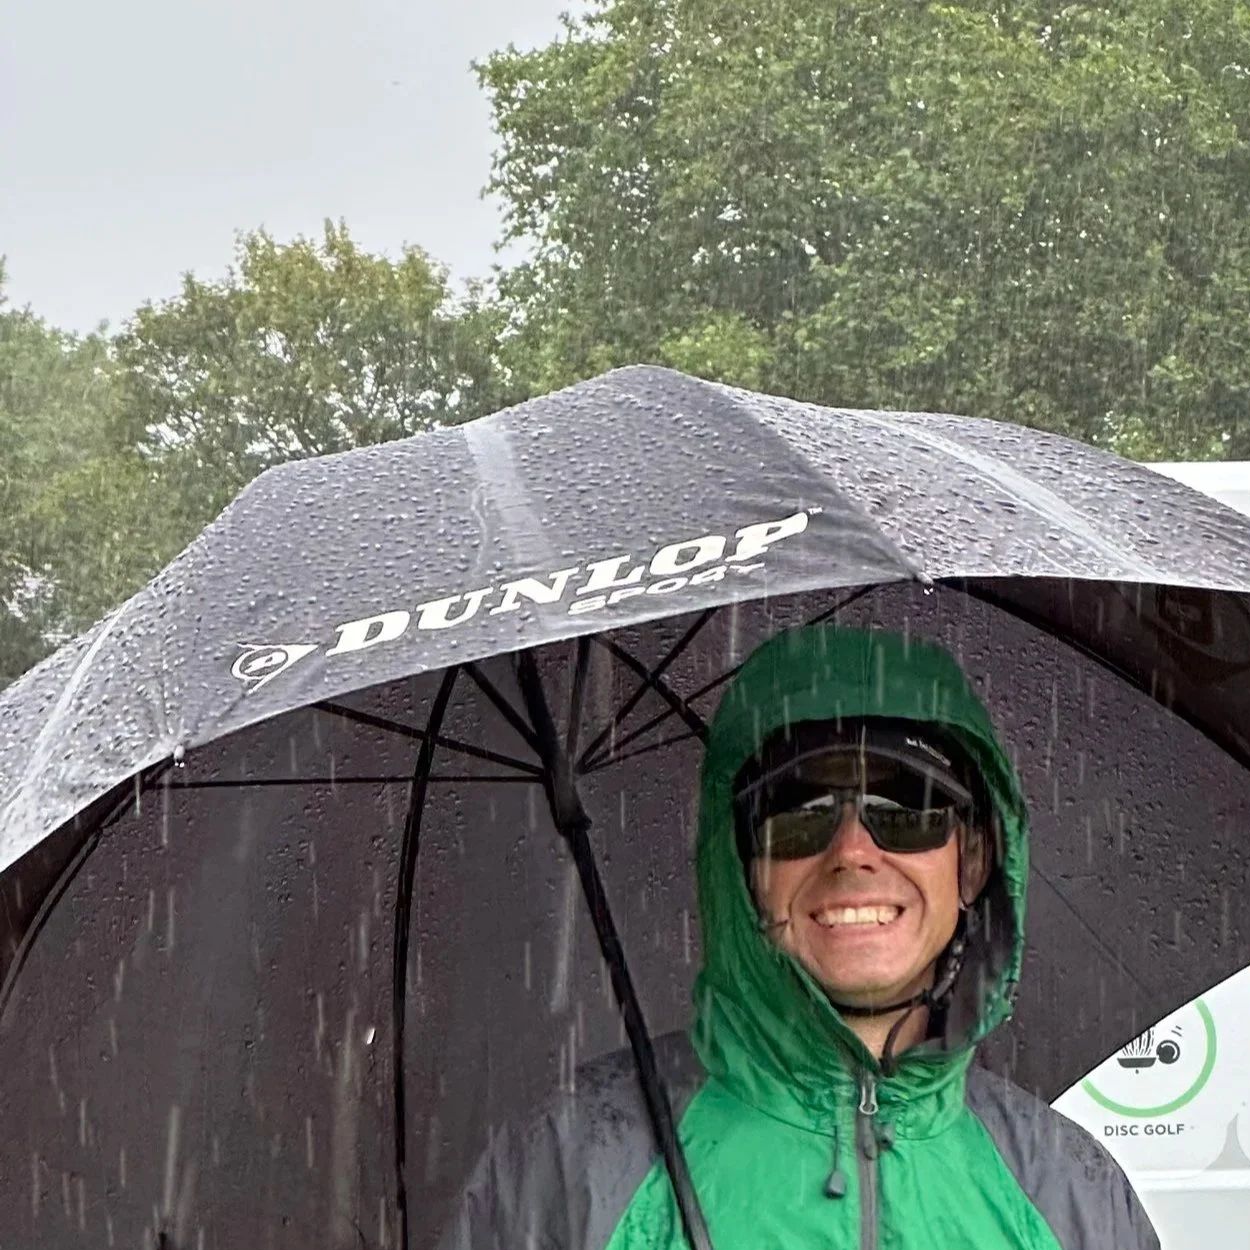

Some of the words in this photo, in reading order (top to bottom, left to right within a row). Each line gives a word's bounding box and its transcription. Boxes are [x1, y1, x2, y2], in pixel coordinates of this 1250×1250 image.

[326, 512, 808, 657] DUNLOP
[567, 563, 765, 615] SPORT
[1104, 1124, 1140, 1137] DISC
[1143, 1123, 1185, 1136] GOLF
